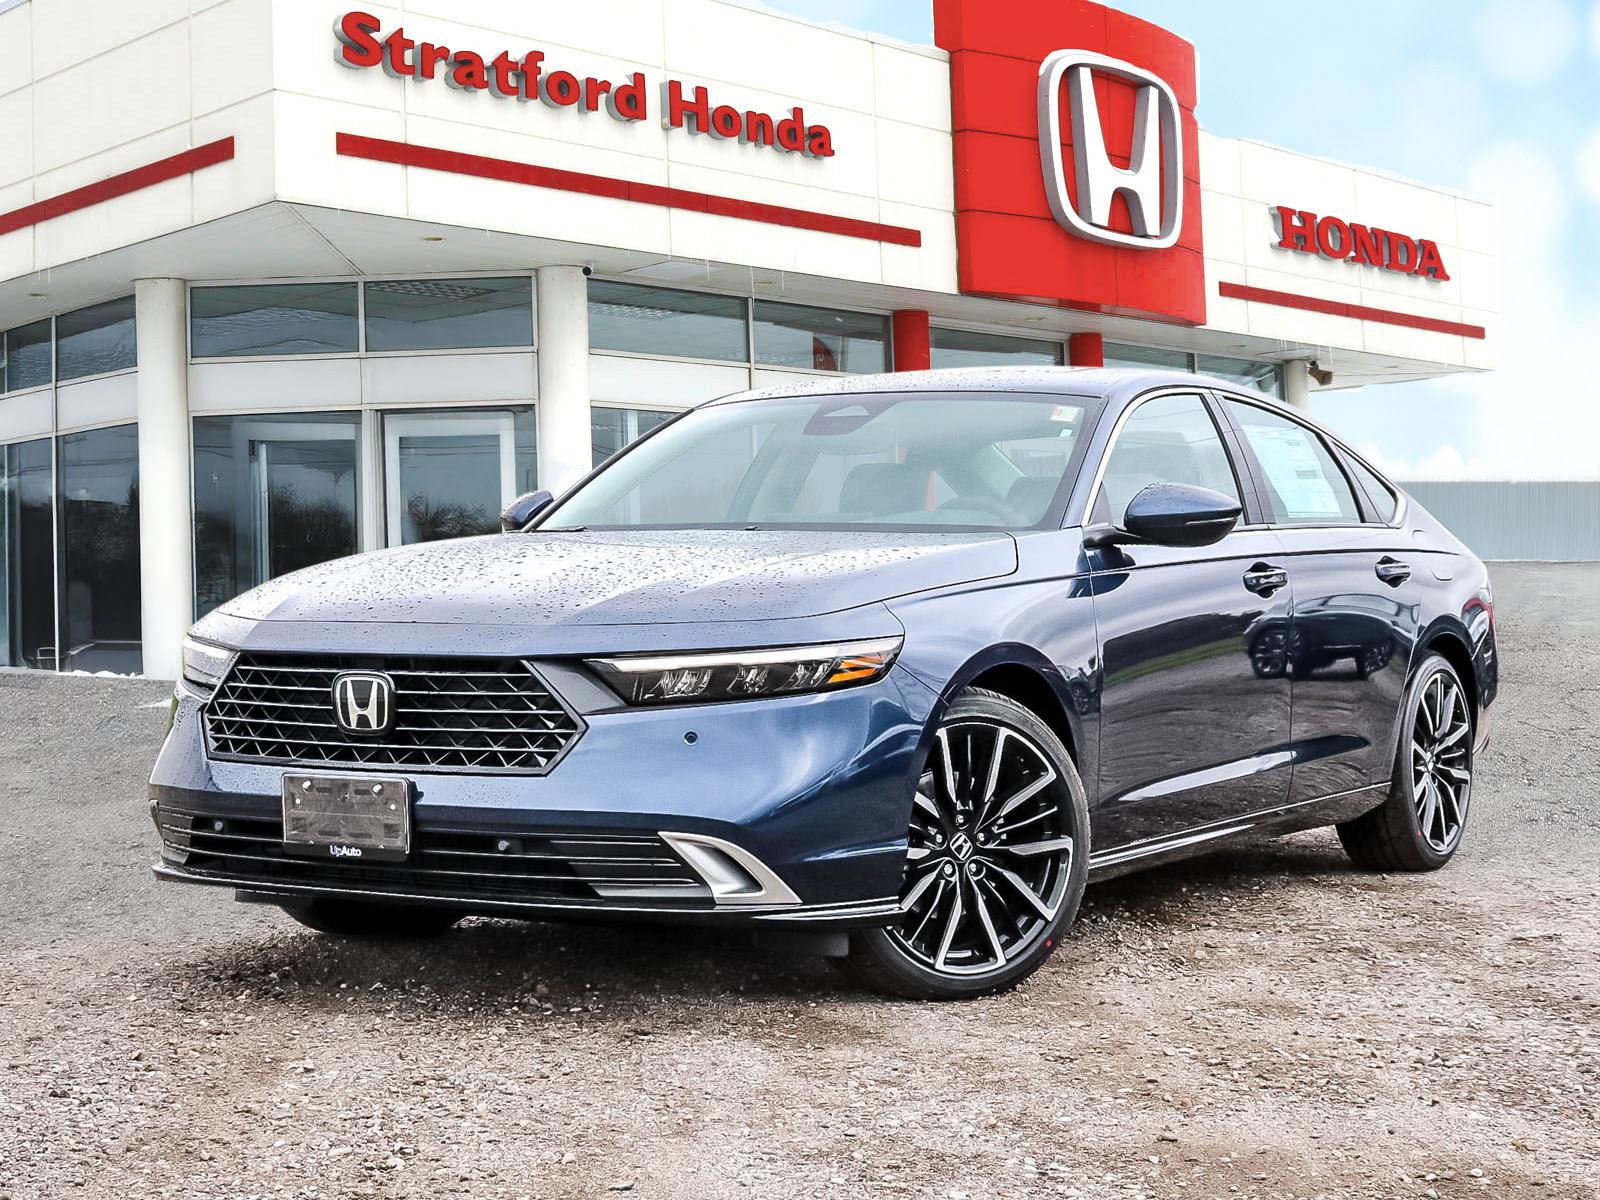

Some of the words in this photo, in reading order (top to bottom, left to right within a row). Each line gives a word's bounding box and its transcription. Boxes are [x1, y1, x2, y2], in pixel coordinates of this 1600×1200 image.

[338, 11, 648, 121] Stratford
[665, 79, 836, 157] Honda
[1271, 205, 1451, 281] HONDA
